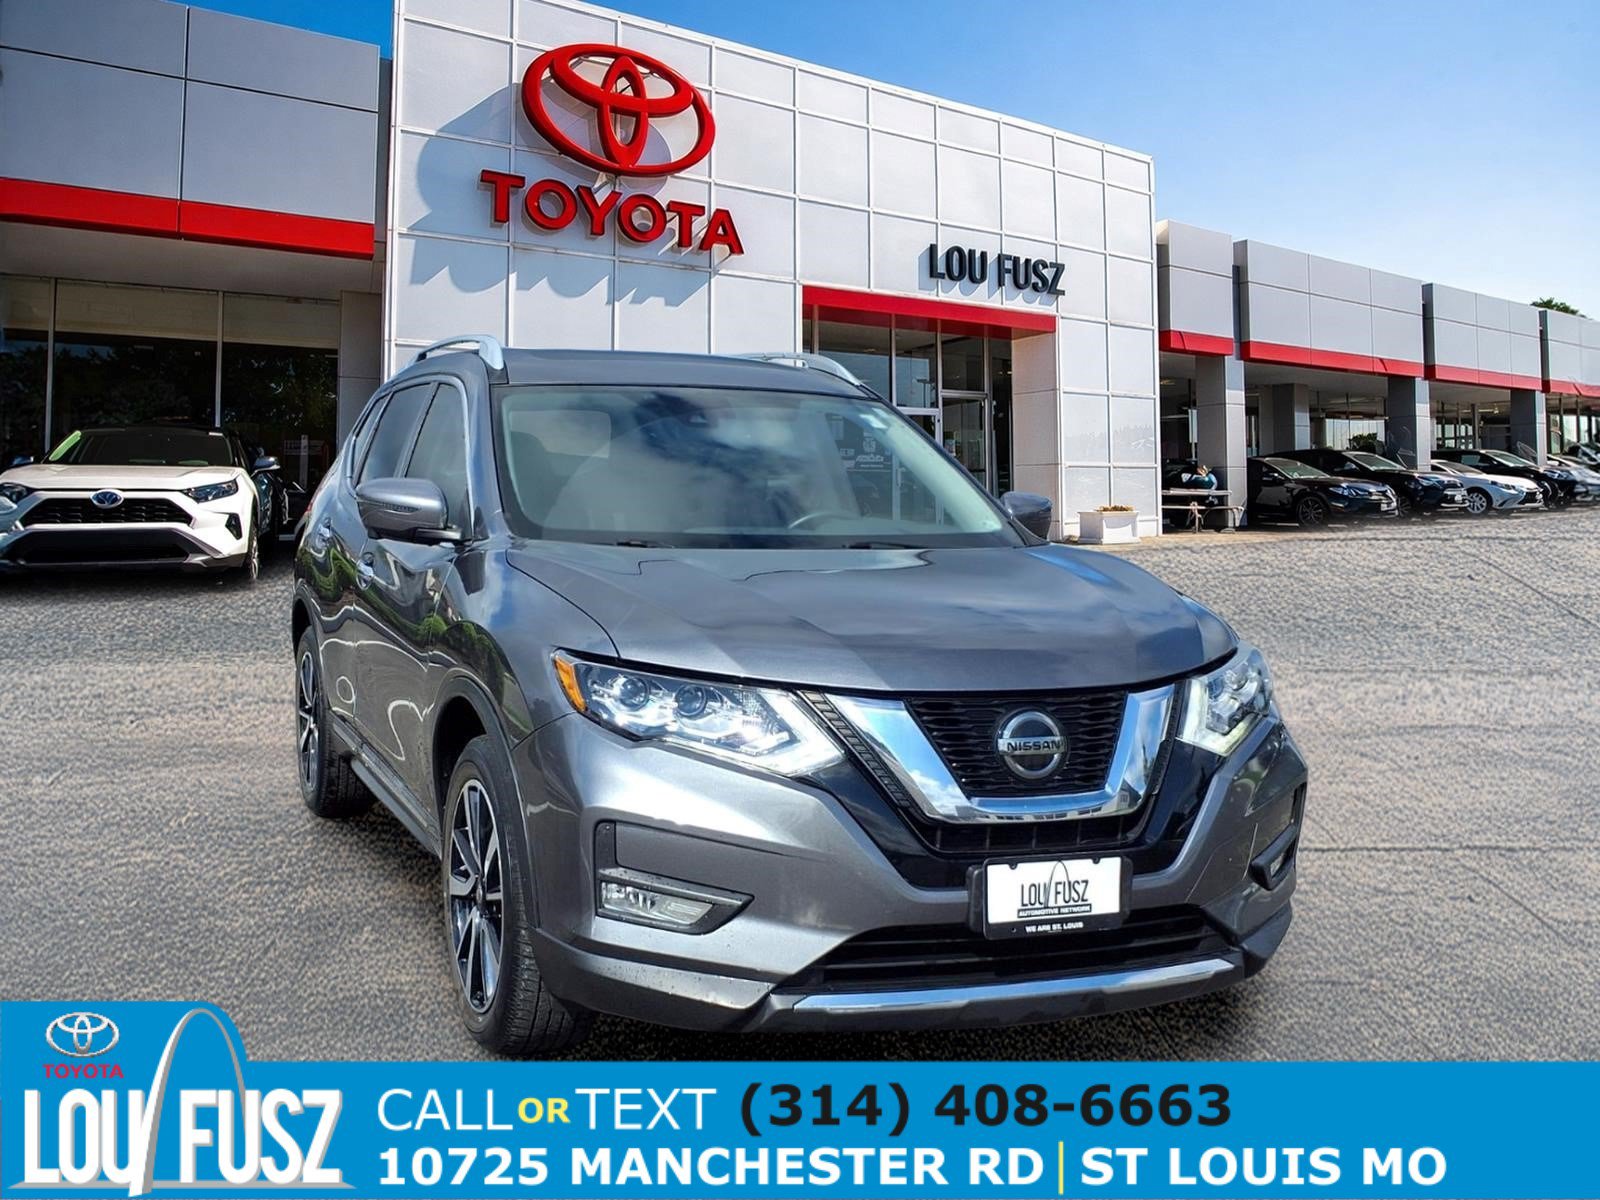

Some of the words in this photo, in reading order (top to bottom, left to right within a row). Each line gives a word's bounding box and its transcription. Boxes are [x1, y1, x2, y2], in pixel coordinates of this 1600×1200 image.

[480, 169, 745, 255] TOYOTA
[929, 243, 988, 285] LOU
[997, 253, 1066, 297] FUSZ
[1007, 740, 1061, 752] NISSAN
[1021, 882, 1047, 907] LOU
[1055, 880, 1089, 905] FUSZ
[1018, 907, 1059, 917] AUTOMOTIVE
[1060, 905, 1091, 914] NETWORK
[1025, 925, 1036, 933] WE
[1037, 924, 1051, 932] ARE
[1063, 921, 1084, 930] LOUIS
